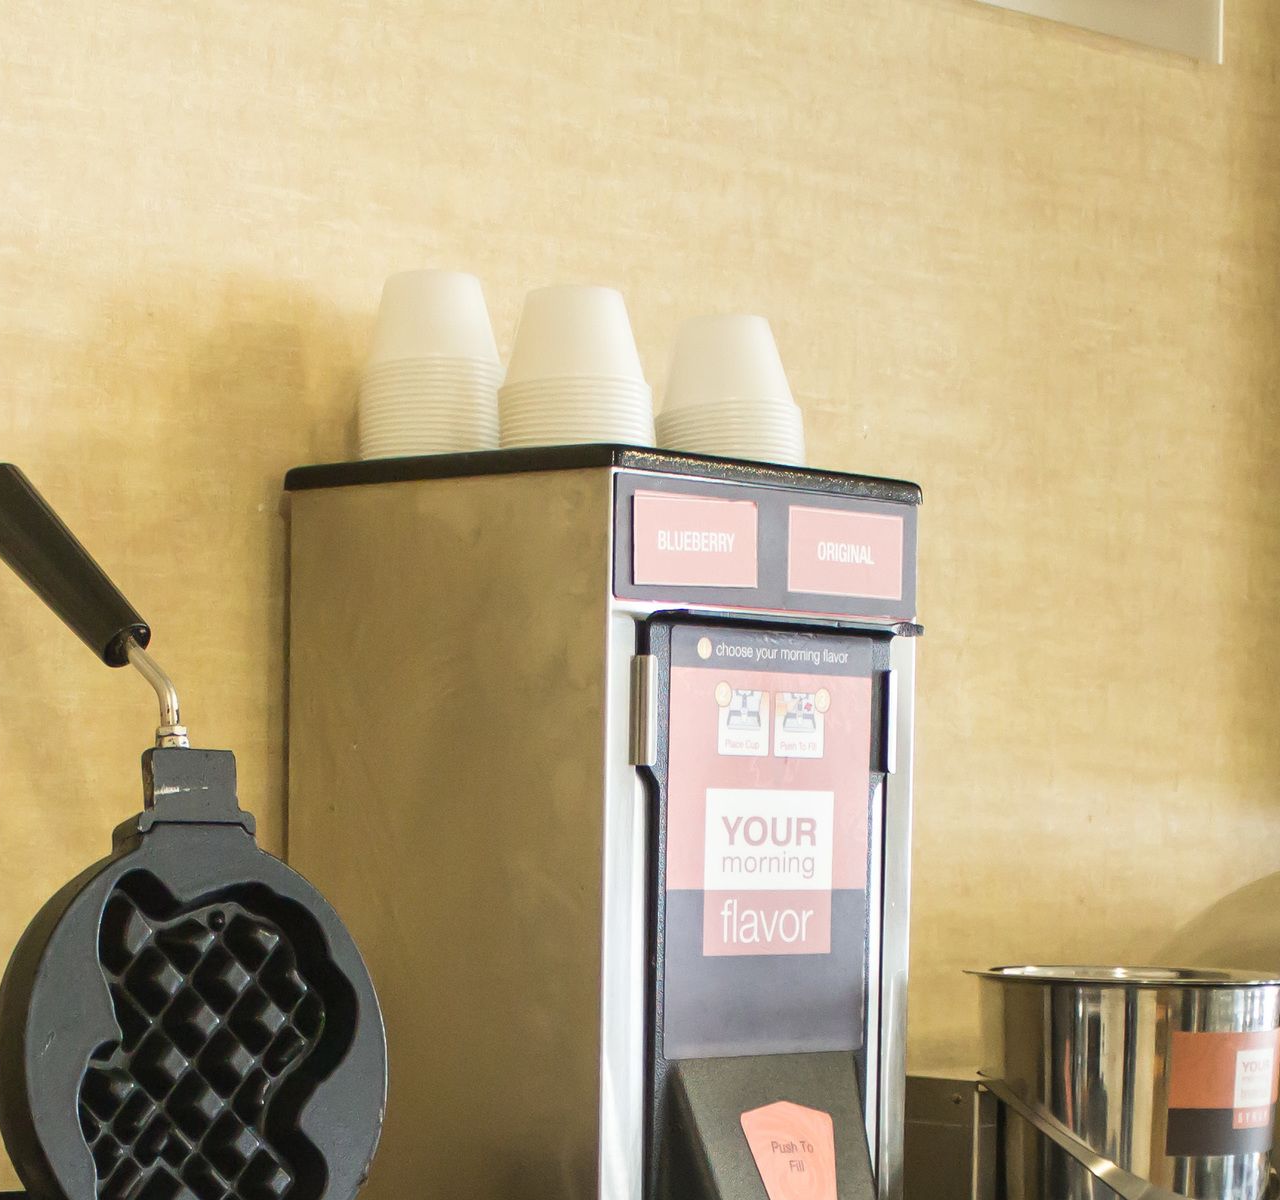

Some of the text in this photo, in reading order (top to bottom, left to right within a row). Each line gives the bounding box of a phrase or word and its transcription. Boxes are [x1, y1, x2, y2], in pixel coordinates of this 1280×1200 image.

[657, 530, 735, 553] BLUEBERRY
[817, 541, 875, 565] ORIGINAL
[715, 642, 754, 658] choose
[755, 646, 779, 663] your
[780, 648, 821, 666] morning
[823, 648, 849, 664] flavor
[721, 815, 817, 848] YOUR
[722, 851, 815, 880] morning
[720, 898, 814, 944] flavor
[771, 1140, 814, 1154] Push To
[789, 1159, 805, 1172] Fill
